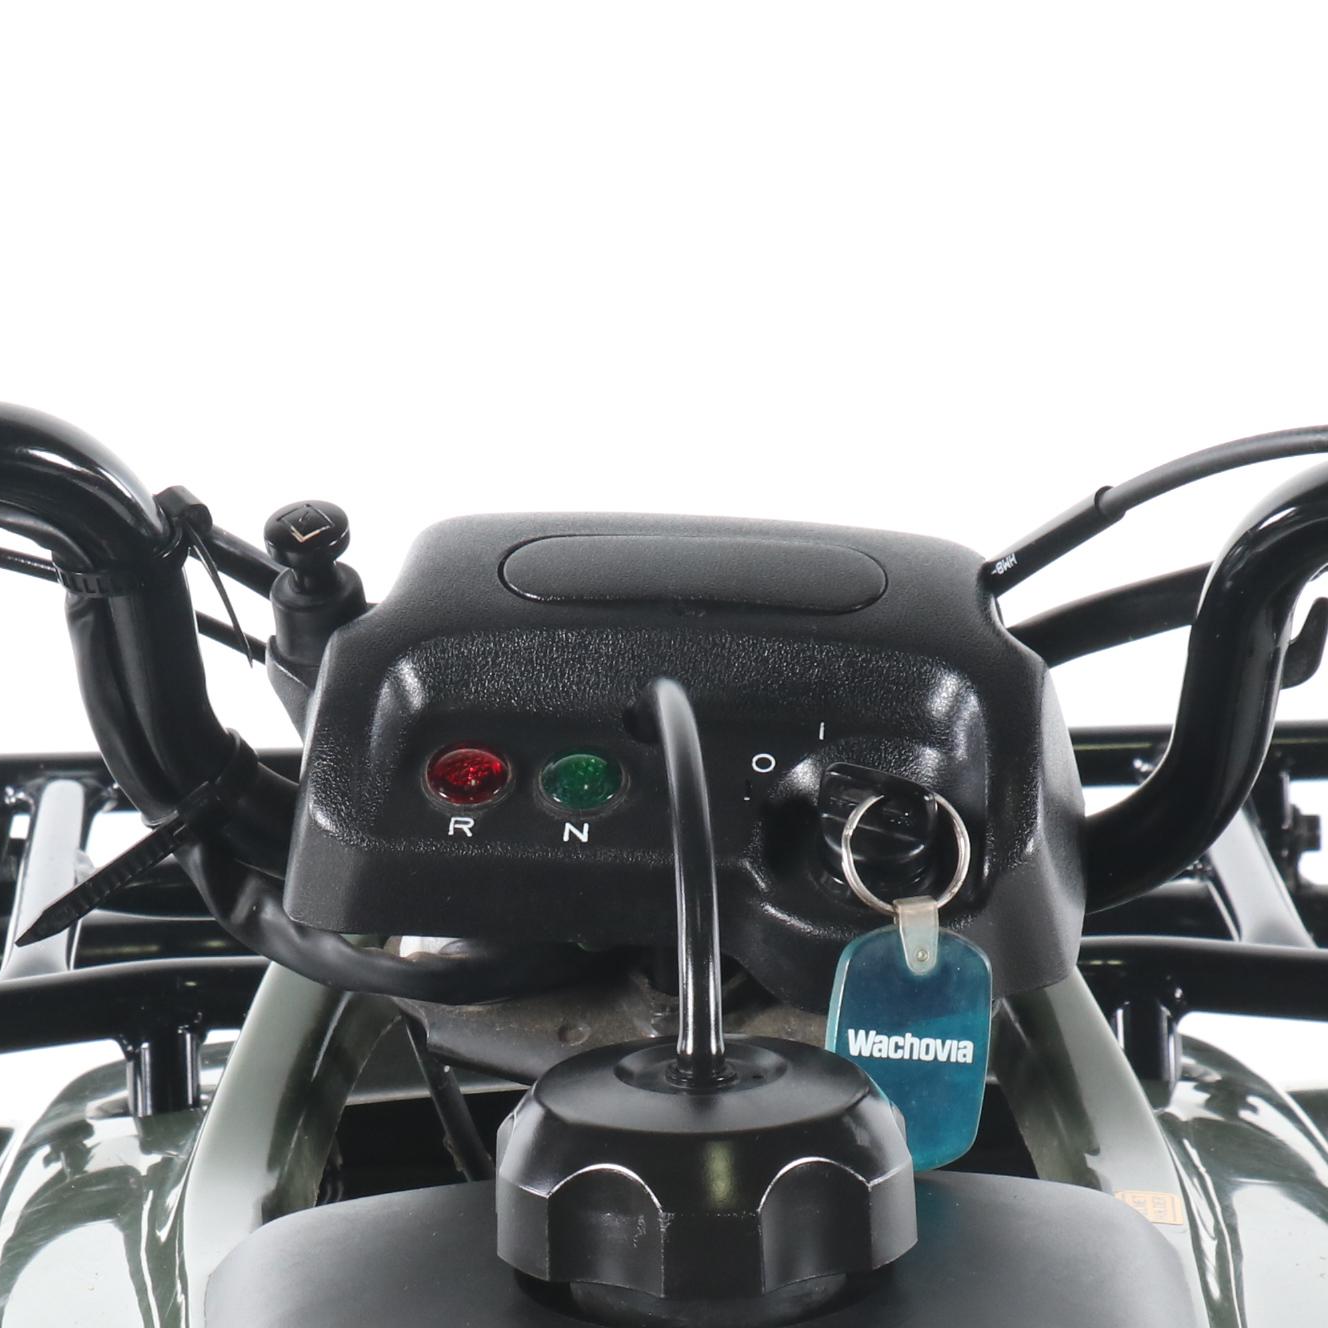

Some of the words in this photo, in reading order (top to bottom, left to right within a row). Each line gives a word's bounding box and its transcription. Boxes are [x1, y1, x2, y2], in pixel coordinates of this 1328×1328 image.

[448, 817, 474, 837] R
[563, 822, 589, 842] N
[848, 1029, 974, 1063] Wachovia
